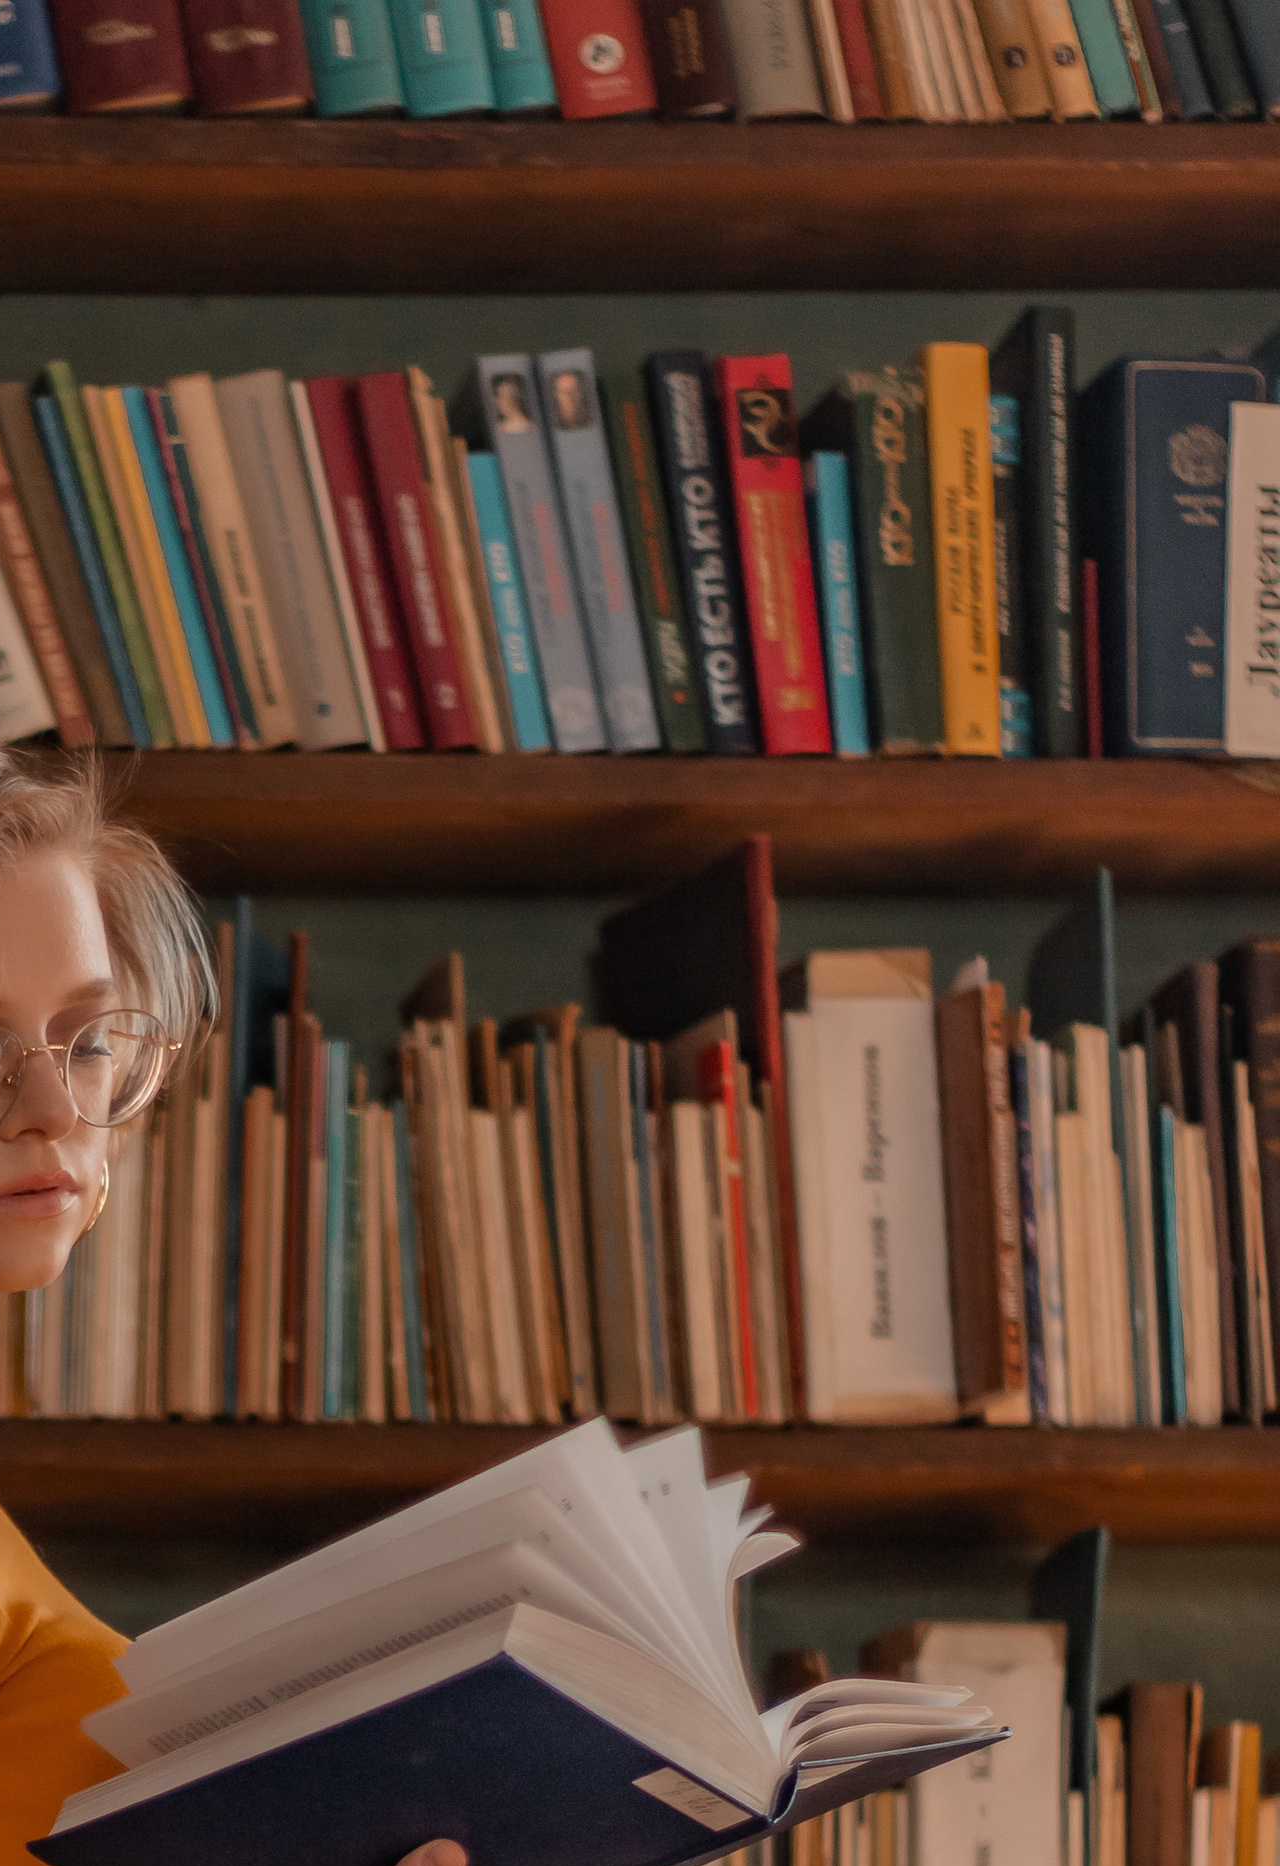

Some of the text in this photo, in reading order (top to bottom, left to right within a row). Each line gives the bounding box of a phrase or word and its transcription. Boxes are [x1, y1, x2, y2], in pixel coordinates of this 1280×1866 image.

[682, 474, 719, 549] КТО
[693, 555, 734, 647] ЕСТЬ
[705, 651, 744, 726] КТО
